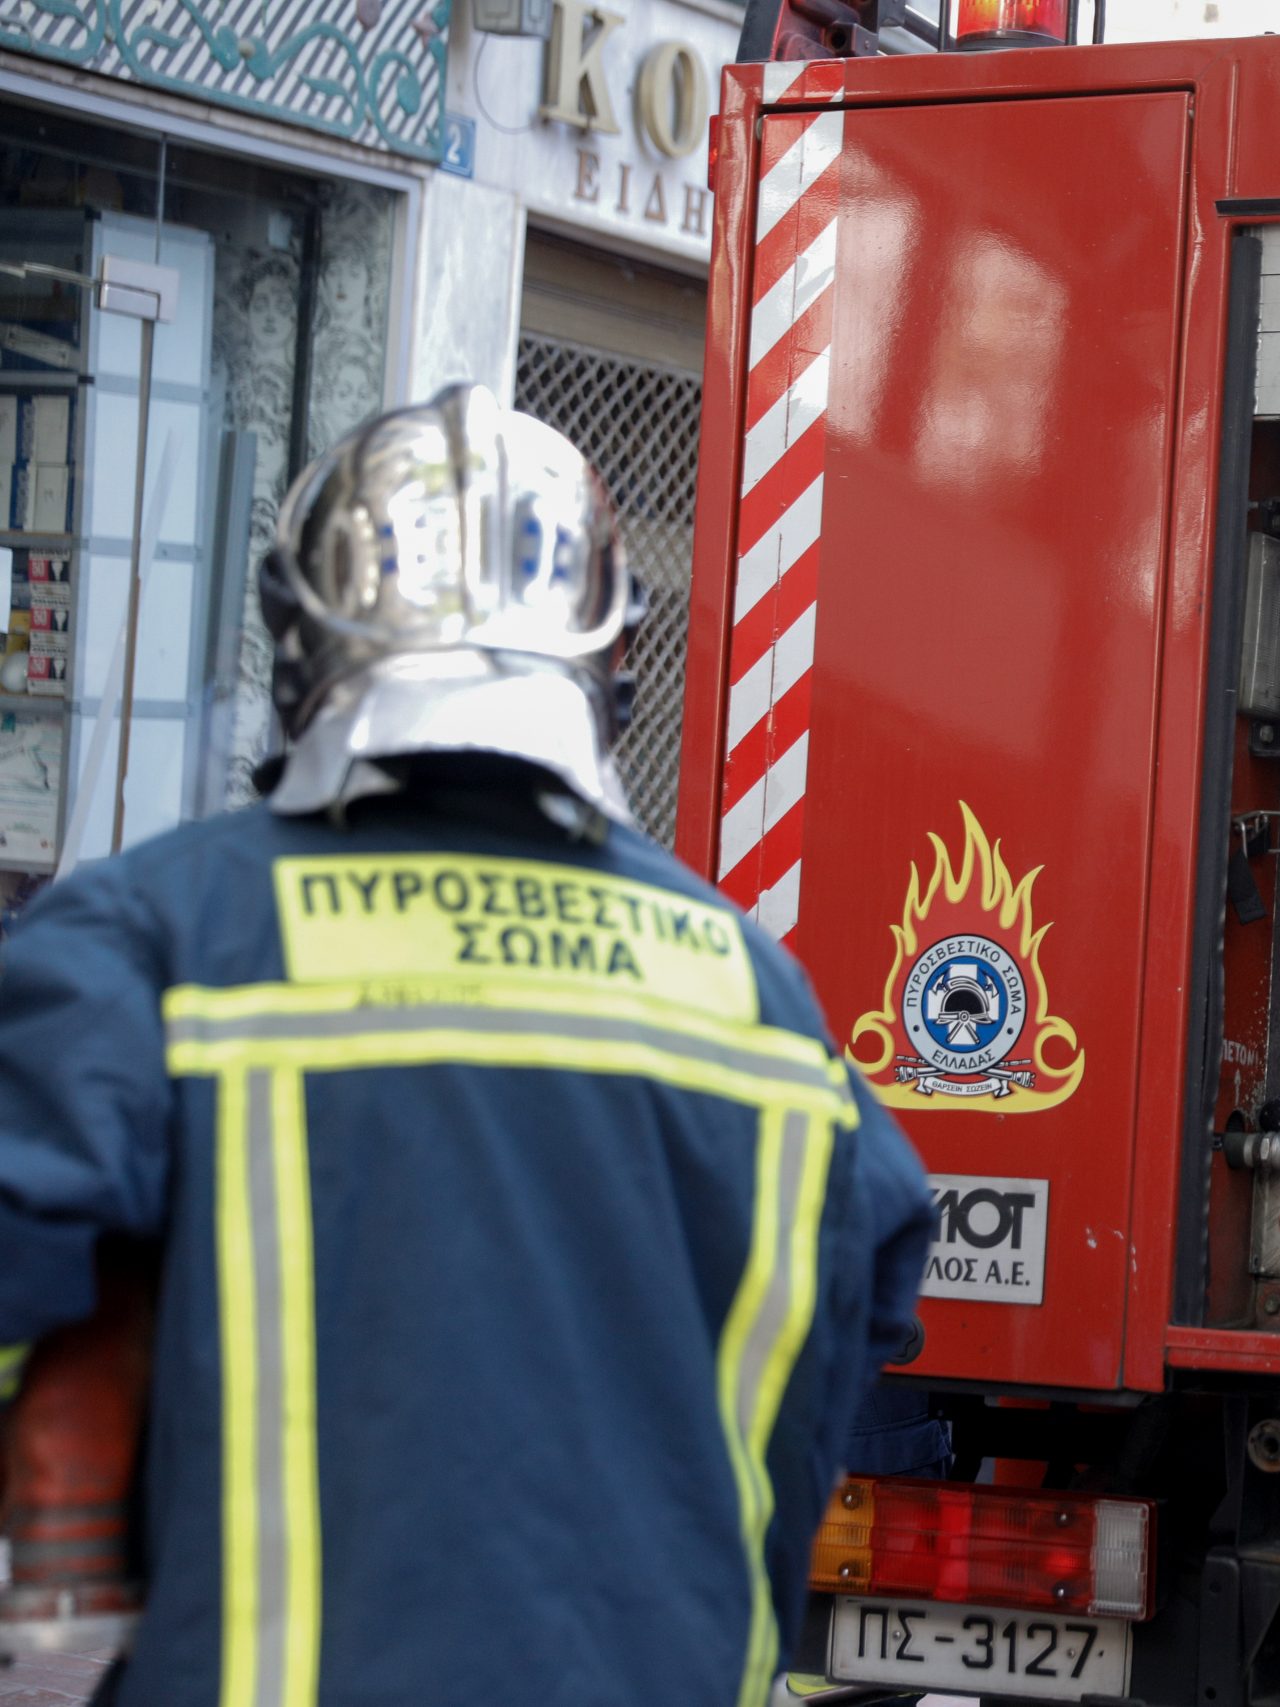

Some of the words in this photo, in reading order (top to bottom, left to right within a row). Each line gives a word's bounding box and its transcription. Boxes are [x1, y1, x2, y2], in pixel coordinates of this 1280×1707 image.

[573, 149, 707, 237] ΕΙΔΗ
[301, 868, 730, 957] ΠΥΡΟΣΒΕΣΤΙΚΟ
[456, 921, 643, 981] ΣΩΜΑ
[906, 940, 1001, 1007] ΠΥΡΟΣΒΕΣΤΙΚΟ
[1002, 965, 1022, 1015] ΣΩΜΑ
[932, 1049, 996, 1070] ΕΛΛΑΔΑΣ
[925, 1255, 978, 1282] ΛΟΣ
[985, 1260, 1031, 1286] Α.Ε.
[857, 1606, 1098, 1679] ΠΣ-3127
